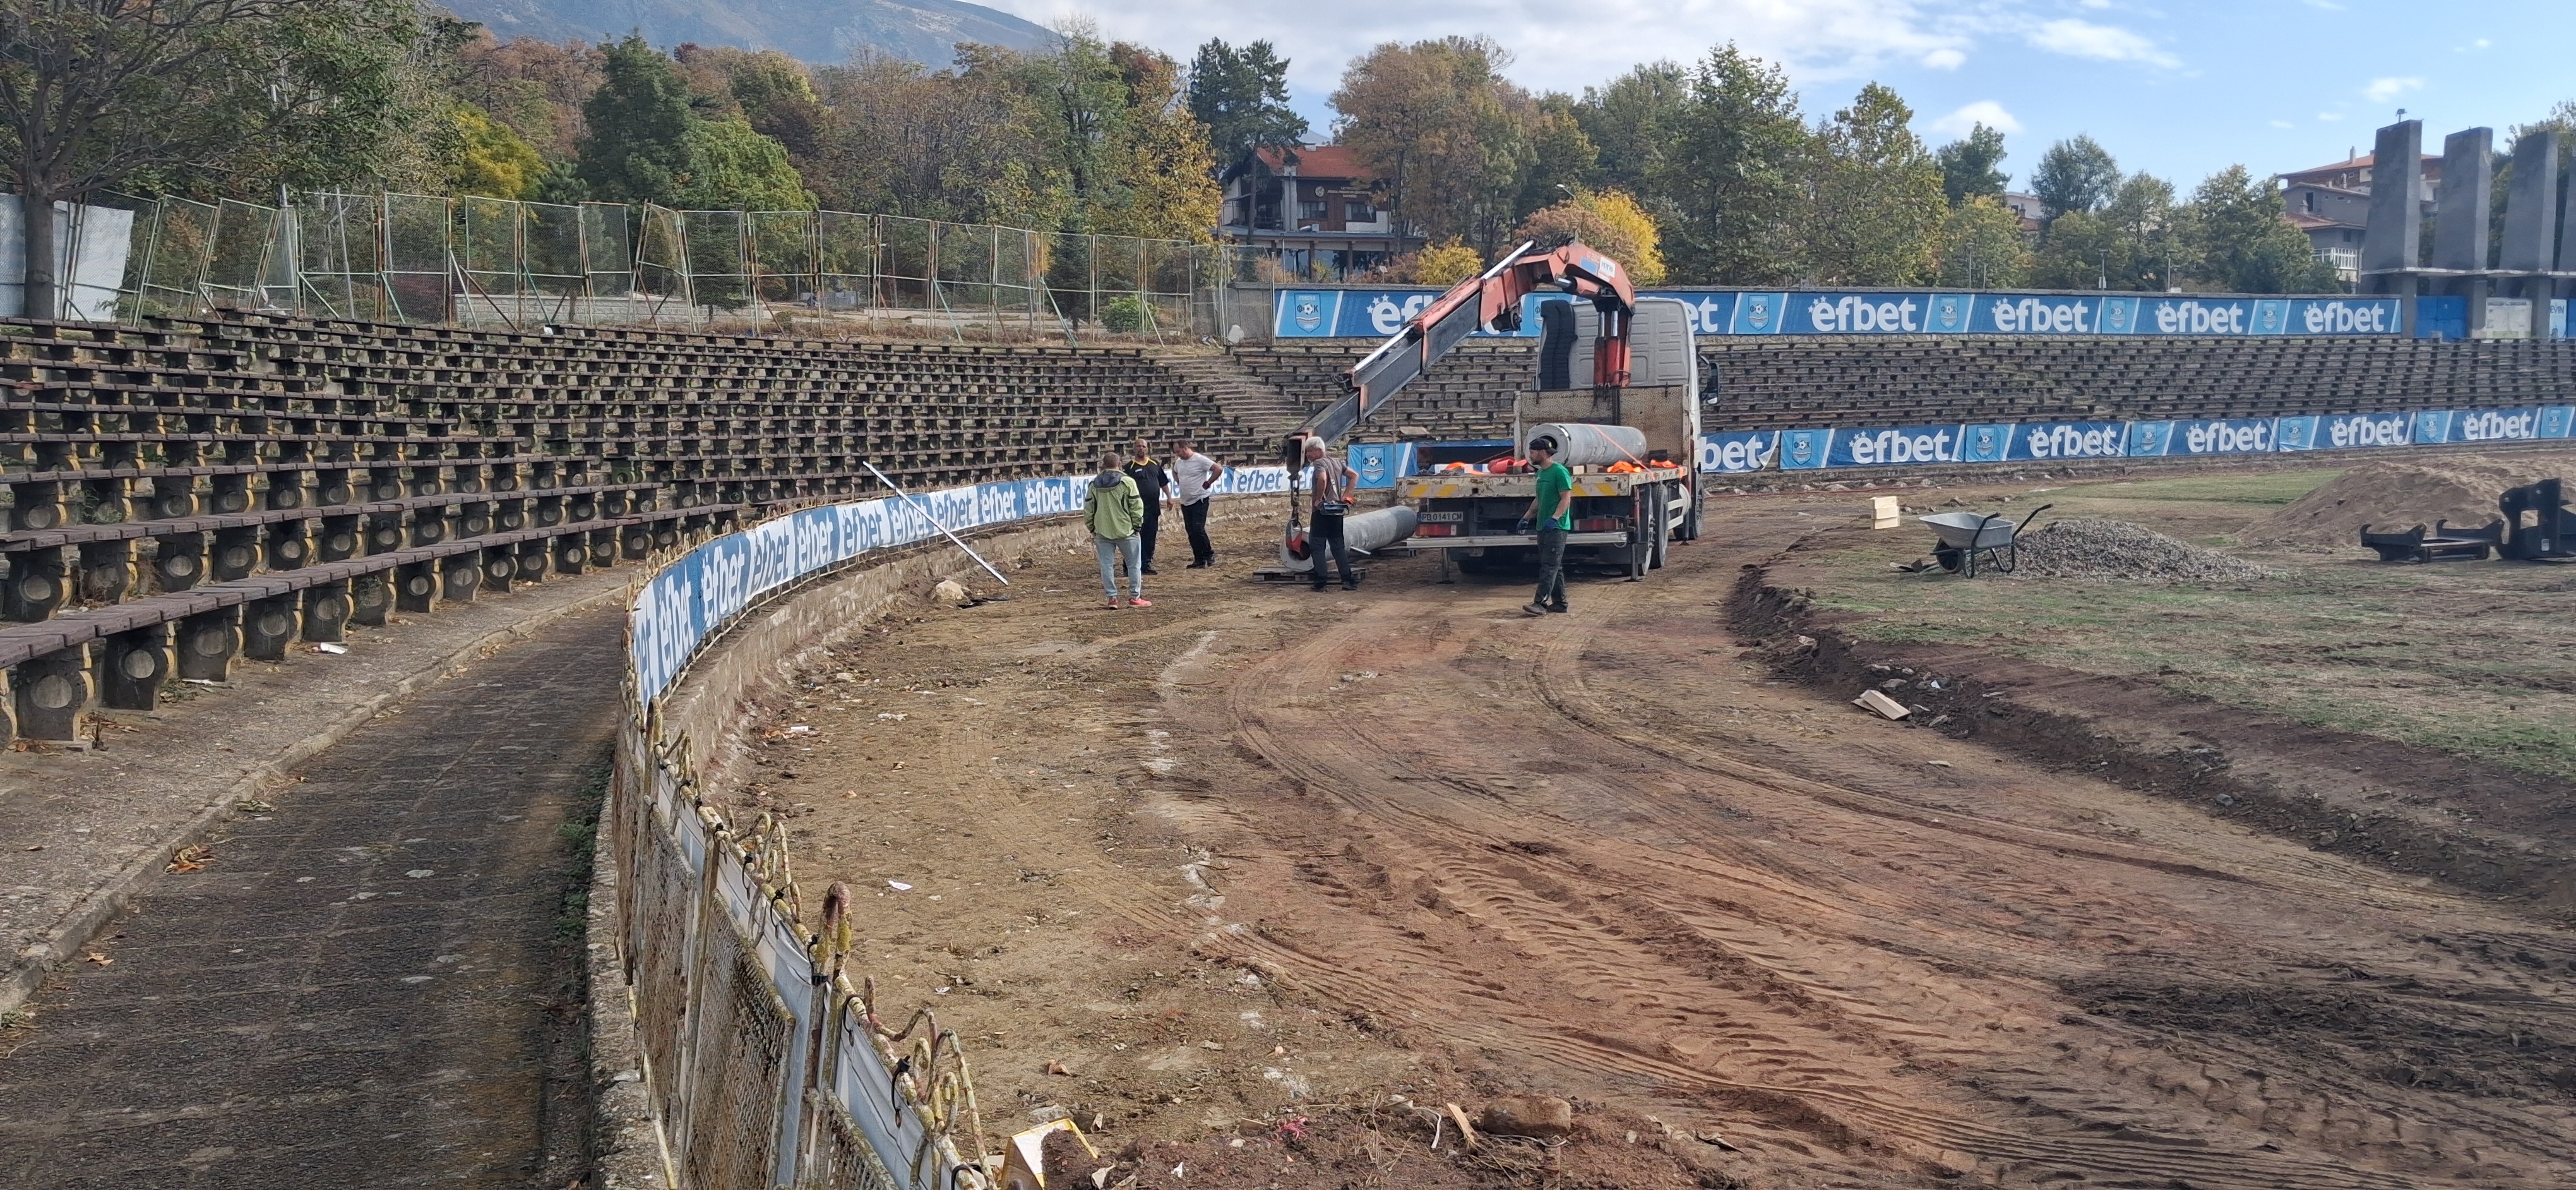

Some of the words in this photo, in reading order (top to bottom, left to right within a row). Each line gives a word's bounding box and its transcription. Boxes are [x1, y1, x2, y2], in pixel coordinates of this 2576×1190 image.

[1811, 296, 1916, 332] efbet
[1994, 298, 2089, 333] efbet
[2157, 302, 2243, 333] efbet
[2306, 302, 2384, 333] efbet
[2030, 426, 2117, 458] efbet
[2188, 422, 2266, 453] efbet
[2332, 416, 2404, 446] efbet
[2464, 411, 2532, 440] efbet
[1700, 435, 1763, 470] bet
[1852, 430, 1953, 464] efbet
[1027, 481, 1066, 515] efbet
[1237, 469, 1284, 492] efbet
[892, 497, 929, 538] efbet
[936, 491, 972, 528] efbet
[982, 485, 1017, 523] efbet
[798, 511, 833, 573] efbet
[844, 505, 884, 556] efbet
[751, 523, 789, 595] efbet
[703, 542, 745, 627] efbet
[660, 564, 694, 679] efbet
